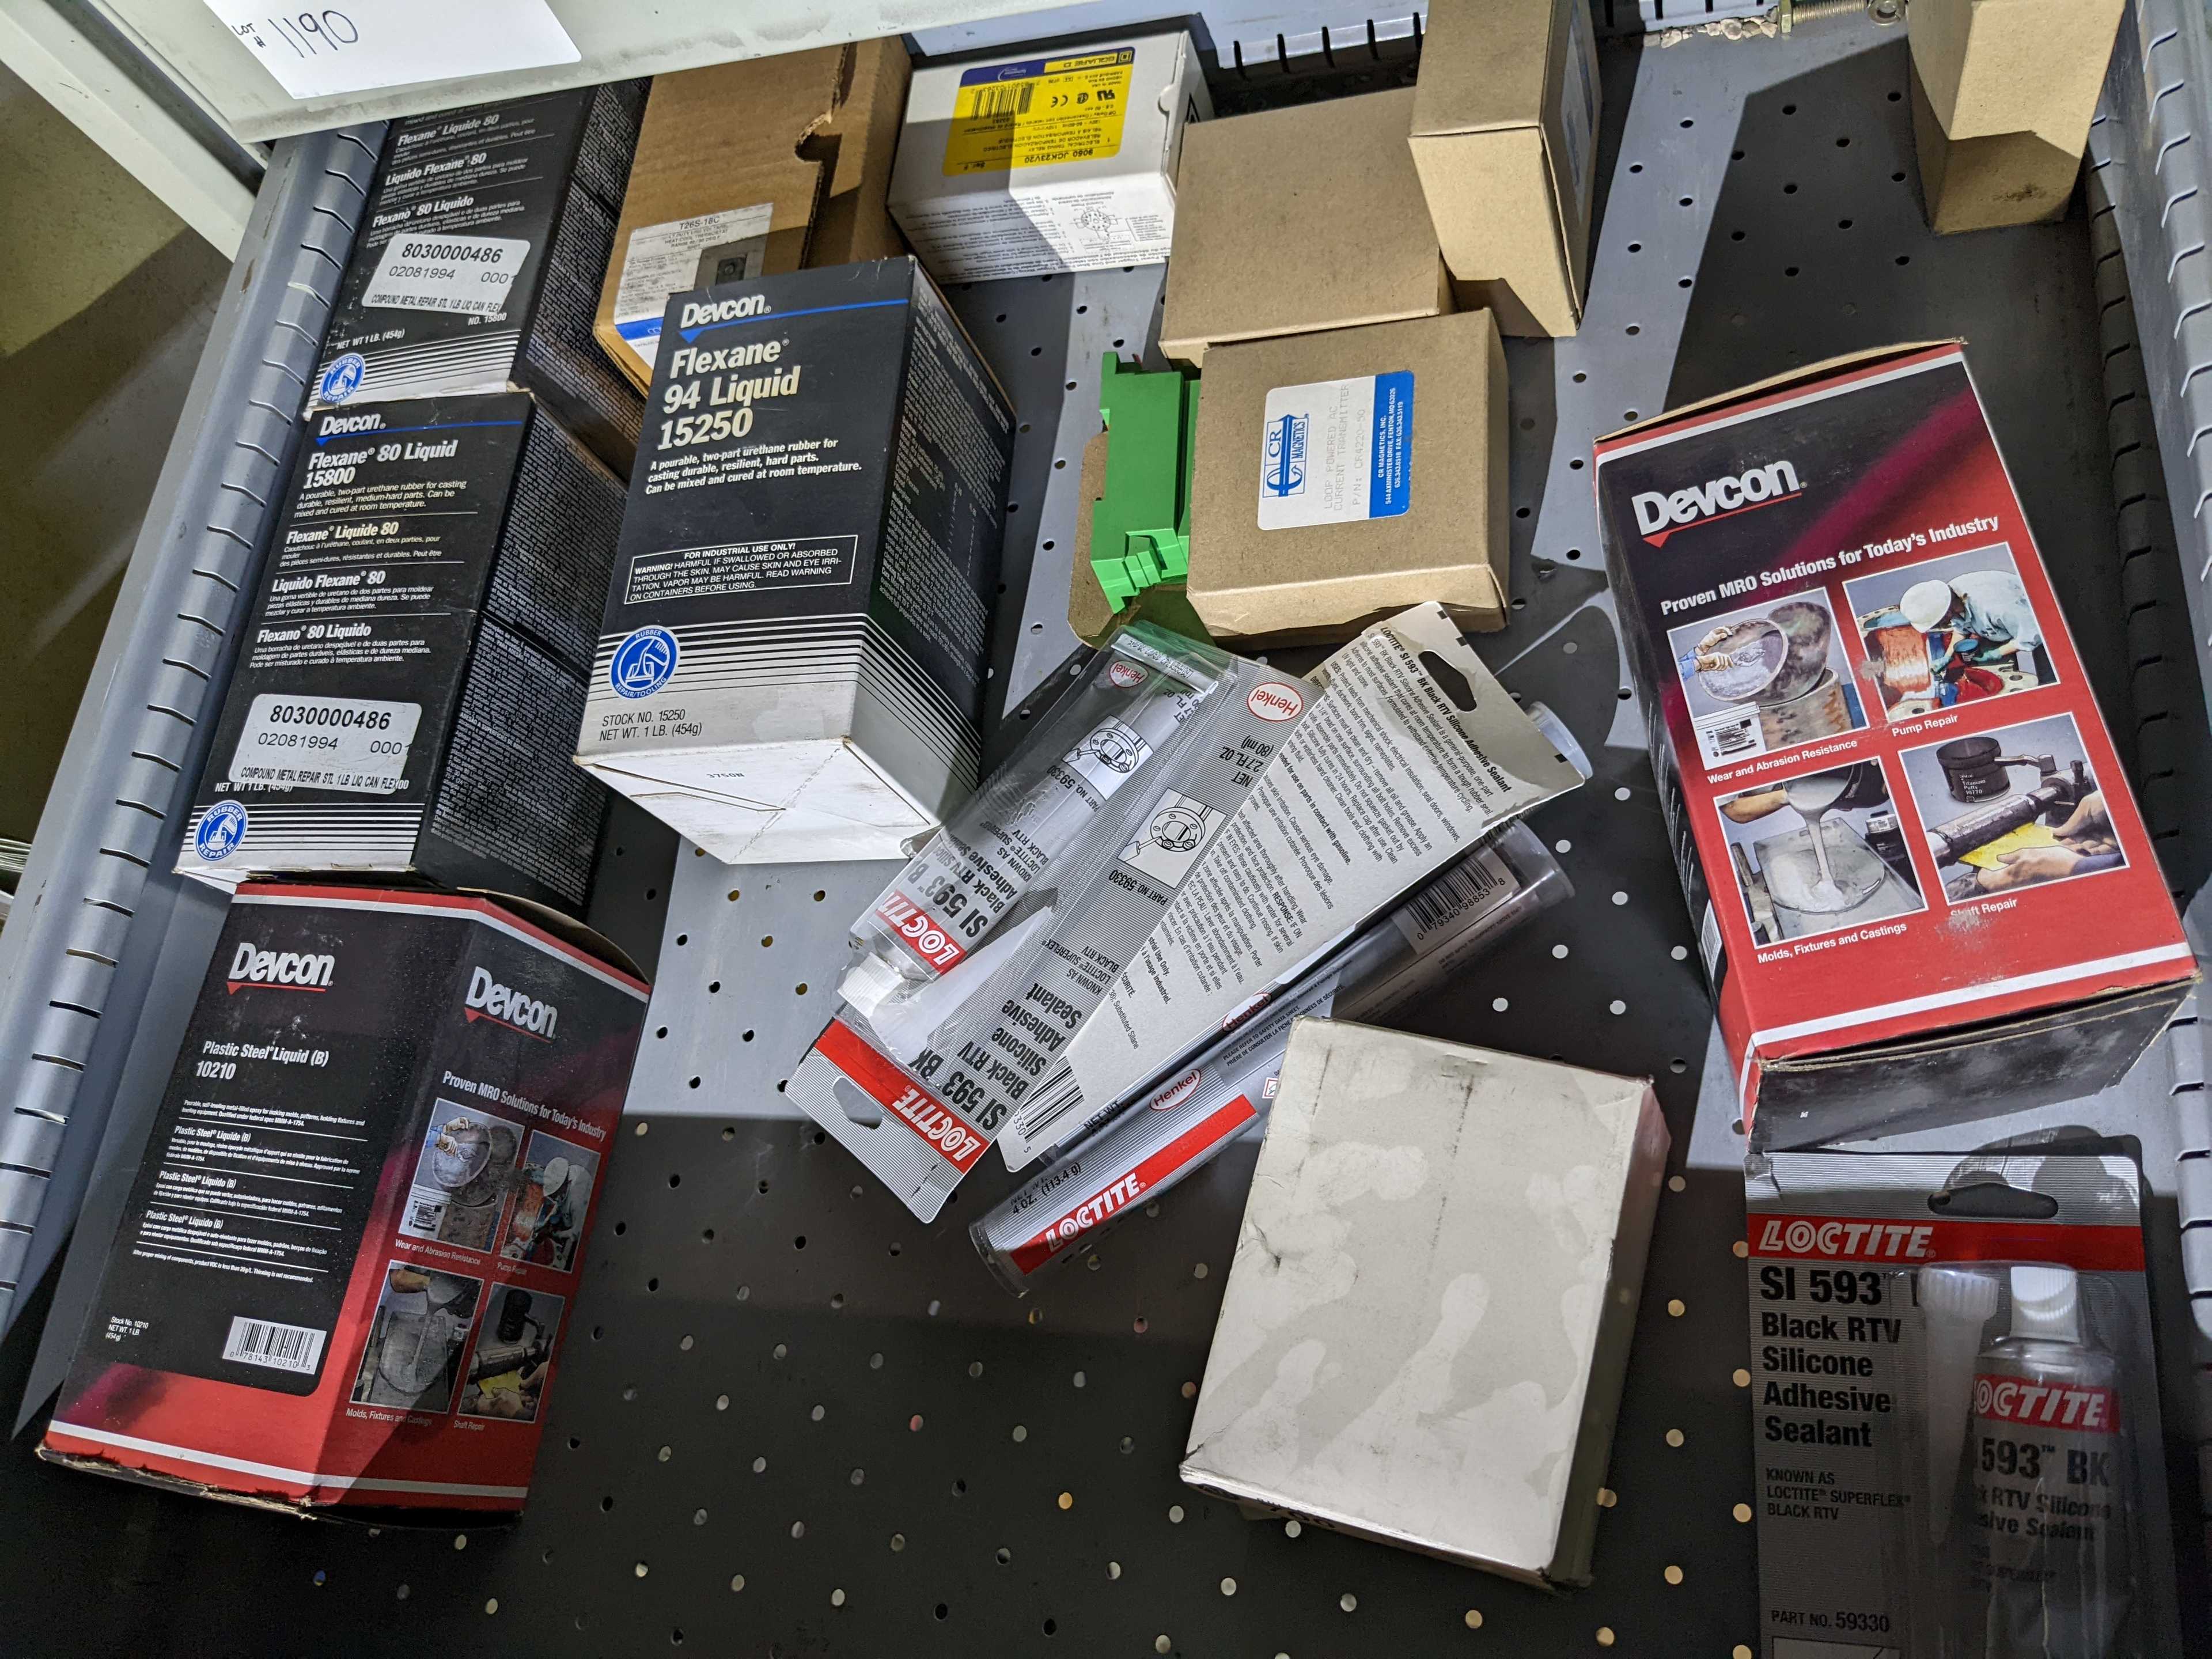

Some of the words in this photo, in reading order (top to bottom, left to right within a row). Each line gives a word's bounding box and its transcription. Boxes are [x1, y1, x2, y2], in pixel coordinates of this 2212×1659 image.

[231, 23, 255, 35] LOT
[268, 10, 358, 58] 1190
[470, 153, 487, 165] 80
[416, 203, 431, 215] 80
[402, 243, 503, 263] 8030000486
[389, 266, 456, 279] 02081994
[663, 380, 700, 415] 94
[709, 365, 801, 407] Liquid
[1329, 406, 1338, 419] AC
[657, 407, 753, 451] 15250
[1291, 421, 1305, 460] MAGNETICS
[377, 445, 401, 462] 80
[404, 440, 459, 462] Liquid
[650, 461, 657, 471] A
[658, 454, 700, 471] pourable,
[702, 448, 740, 463] two-part
[743, 442, 785, 456] urethane
[787, 440, 821, 452] rubber
[823, 438, 838, 448] for
[1268, 429, 1282, 457] CR
[1327, 426, 1336, 472] POWERED
[303, 467, 356, 489] 15800
[646, 484, 661, 495] Can
[664, 482, 675, 491] be
[677, 478, 706, 489] mixed
[708, 475, 725, 485] and
[727, 472, 753, 482] cured
[756, 471, 766, 479] at
[768, 468, 794, 478] room
[797, 461, 862, 475] temperature.
[1334, 465, 1345, 510] CURRENT
[1324, 479, 1334, 509] LOOP
[684, 552, 701, 560] FOR
[702, 547, 749, 558] INDUSTRIAL
[771, 543, 796, 552] ONLY!
[1660, 589, 1717, 615] Proven
[1719, 577, 1757, 599] MRO
[1760, 555, 1836, 583] Solutions
[1839, 548, 1862, 566] for
[1864, 533, 1926, 559] Today's
[1930, 516, 1999, 542] Industry
[630, 593, 642, 601] ON
[643, 587, 693, 599] CONTAINERS
[695, 584, 727, 593] BEFORE
[729, 581, 756, 590] USING.
[307, 624, 324, 639] 80
[326, 623, 372, 638] Liquido
[634, 629, 662, 639] RUBBER
[1112, 664, 1144, 683] Henkel
[1251, 690, 1298, 715] Henkel
[270, 704, 392, 730] 8030000486
[602, 713, 634, 728] STOCK
[637, 711, 654, 724] NO.
[658, 709, 686, 721] 15250
[1400, 652, 1410, 662] SI
[1417, 676, 1427, 689] BK
[1423, 687, 1442, 706] Black
[1437, 702, 1451, 717] RTV
[1446, 714, 1469, 741] Silicone
[1465, 736, 1493, 768] Adhesive
[1487, 763, 1512, 793] Sealant
[1891, 722, 1923, 738] Pump
[1925, 714, 1959, 734] Repair
[258, 733, 338, 750] 02081994
[599, 728, 618, 742] NET
[621, 726, 639, 739] WT.
[644, 726, 649, 737] 1
[652, 724, 668, 737] LB.
[671, 721, 702, 737] (454g)
[1241, 735, 1258, 749] ml)
[1219, 747, 1234, 760] OZ.
[1236, 752, 1248, 767] FL.
[1256, 744, 1274, 758] (80
[1707, 770, 1733, 784] Wear
[1734, 764, 1755, 778] and
[1756, 752, 1800, 774] Abrasion
[1801, 738, 1858, 763] Resistance
[1247, 759, 1264, 772] 2.7
[1232, 771, 1253, 787] NET
[207, 804, 244, 821] RUBBER
[1313, 809, 1332, 832] contact
[1325, 827, 1336, 842] with
[1332, 839, 1351, 865] gasoline.
[199, 842, 236, 858] REPAIR
[1109, 870, 1139, 891] 59330
[1138, 884, 1149, 894] NO.
[1147, 890, 1168, 906] PART
[1980, 897, 2018, 915] Repair
[877, 892, 960, 965] LOCTIT
[1757, 947, 1793, 964] Molds,
[1795, 937, 1840, 957] Fixtures
[1842, 932, 1858, 947] and
[1859, 922, 1907, 944] Castings
[465, 965, 558, 1038] Devcon
[1026, 983, 1082, 1029] Sealant
[1001, 999, 1066, 1052] Adhesive
[1223, 1047, 1240, 1060] PLEASE
[1238, 1038, 1253, 1049] REFER
[1259, 1024, 1275, 1036] SAFETY
[1275, 1015, 1286, 1025] DATA
[203, 1040, 238, 1058] Plastic
[272, 1047, 309, 1065] Liquid
[311, 1050, 329, 1067] (B)
[957, 1041, 988, 1071] RTV
[992, 1027, 1046, 1076] Silicone
[196, 1060, 236, 1080] 10210
[988, 1059, 1029, 1100] Black
[1153, 1070, 1198, 1107] Henkel
[442, 1070, 477, 1093] Proven
[478, 1082, 500, 1101] MRO
[501, 1090, 539, 1116] Solutions
[540, 1105, 552, 1119] for
[551, 1109, 578, 1130] Today's
[579, 1119, 607, 1142] Industry
[975, 1099, 1006, 1130] SI
[1760, 1267, 1795, 1301] SI
[111, 1317, 124, 1325] Stock
[134, 1320, 149, 1329] 10210
[1762, 1313, 1839, 1342] Black
[1848, 1317, 1901, 1343] RTV
[1762, 1347, 1873, 1377] Silicone
[1763, 1382, 1891, 1412] Adhesive
[1973, 1381, 2106, 1427] OCTITE
[1764, 1415, 1872, 1447] Sealant
[1766, 1468, 1815, 1484] KNOWN
[1817, 1472, 1835, 1485] AS
[1767, 1503, 1810, 1518] BLACK
[1813, 1506, 1839, 1520] RTV
[1771, 1610, 1805, 1625] PART
[1809, 1613, 1832, 1629] NO.
[1835, 1612, 1890, 1633] 59330
